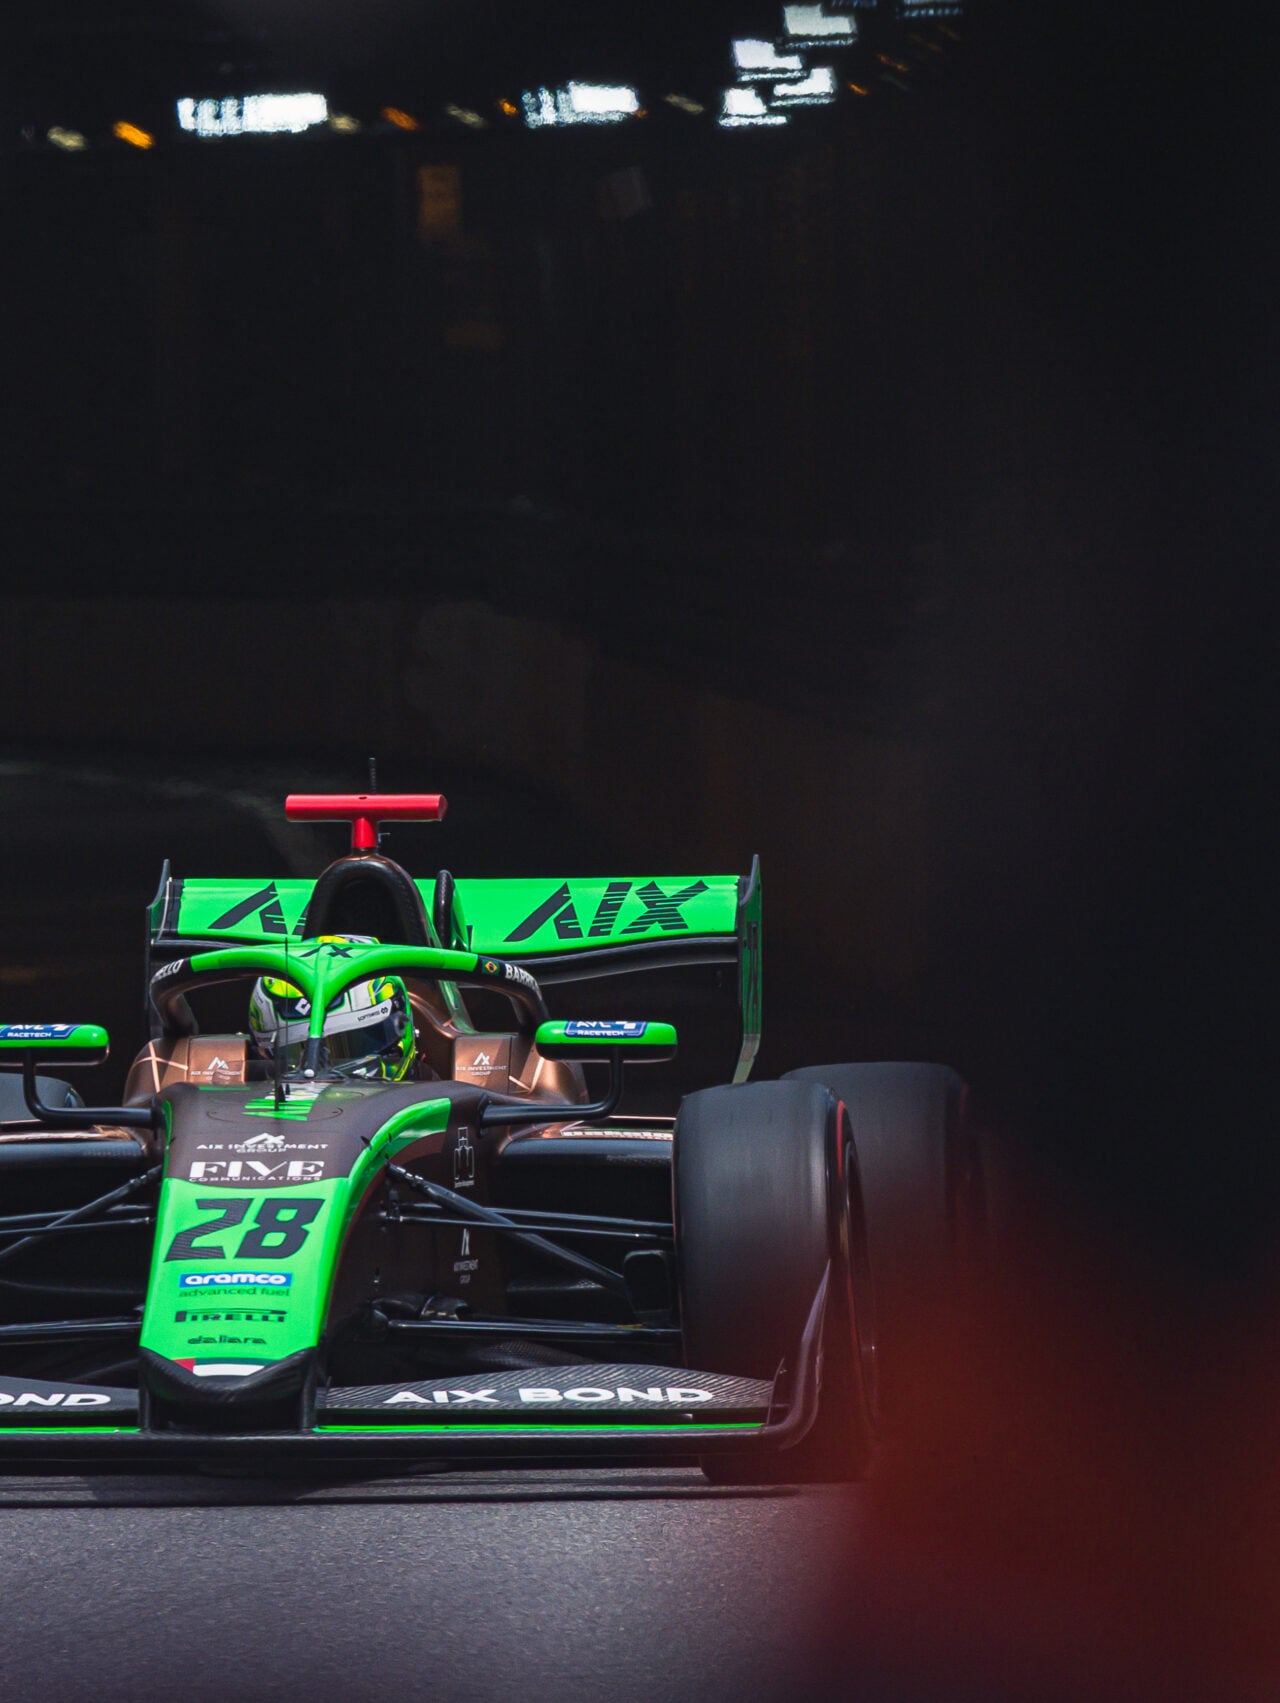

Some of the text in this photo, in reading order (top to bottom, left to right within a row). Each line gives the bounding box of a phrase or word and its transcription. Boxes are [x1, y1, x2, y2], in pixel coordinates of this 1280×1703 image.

[502, 879, 709, 942] AIX
[577, 1029, 624, 1037] RACETECH
[189, 1160, 325, 1178] FIVE
[163, 1198, 326, 1262] 28
[184, 1273, 287, 1285] aramco
[179, 1287, 290, 1297] advanced fuel
[174, 1308, 288, 1323] PIRELLI
[187, 1335, 267, 1345] dallara
[382, 1387, 714, 1404] AIX BOND
